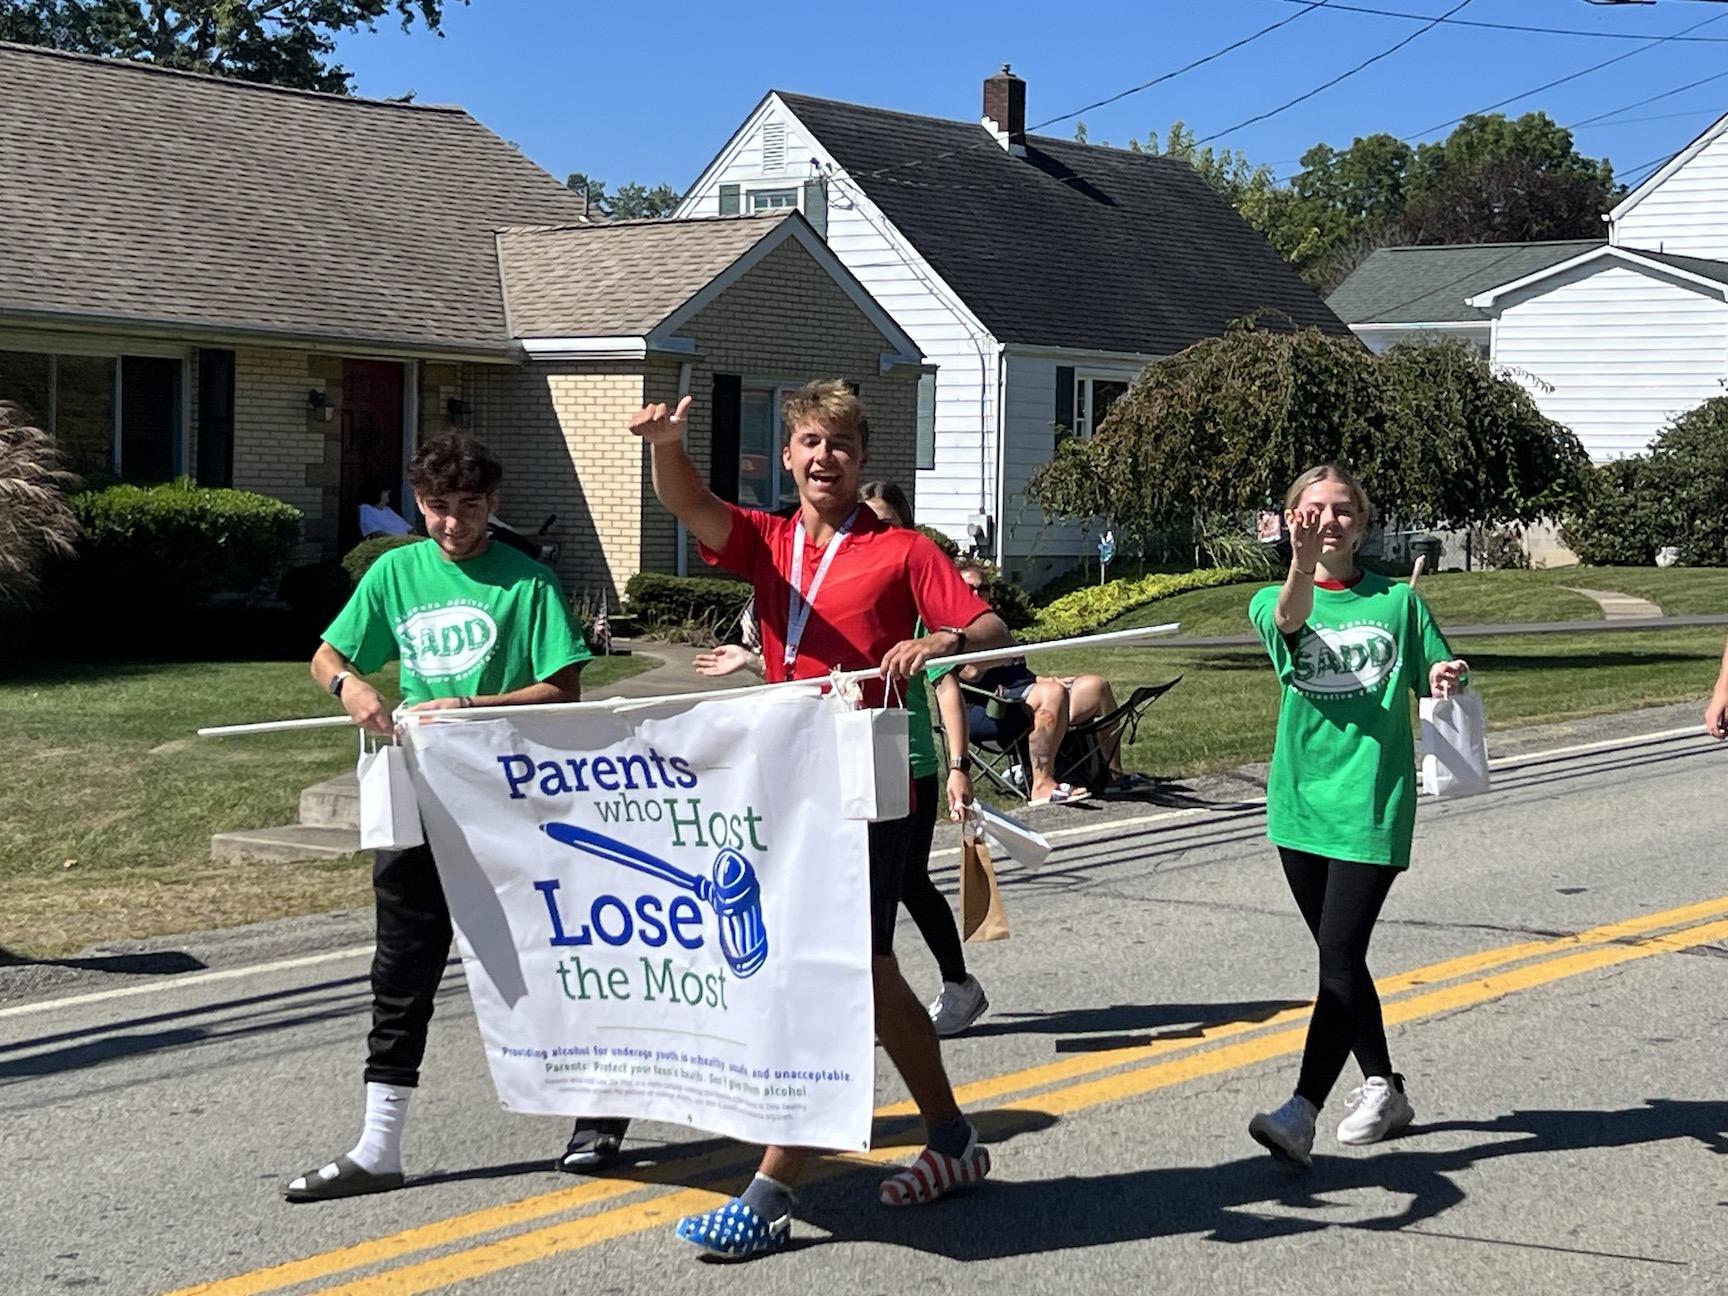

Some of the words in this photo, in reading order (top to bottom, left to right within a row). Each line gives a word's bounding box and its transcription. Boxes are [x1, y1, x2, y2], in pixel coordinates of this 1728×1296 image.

[1293, 635, 1393, 681] SADD
[497, 747, 698, 799] Parents
[594, 793, 662, 823] who
[664, 798, 768, 852] Host
[533, 879, 704, 949] Lose
[556, 956, 630, 1001] the
[640, 957, 728, 1011] Most
[502, 1046, 548, 1060] Providing
[552, 1045, 591, 1057] alcohol
[593, 1045, 608, 1056] for
[681, 1052, 689, 1062] is
[752, 1067, 770, 1079] and
[593, 1060, 628, 1073] Protect
[631, 1064, 652, 1077] your
